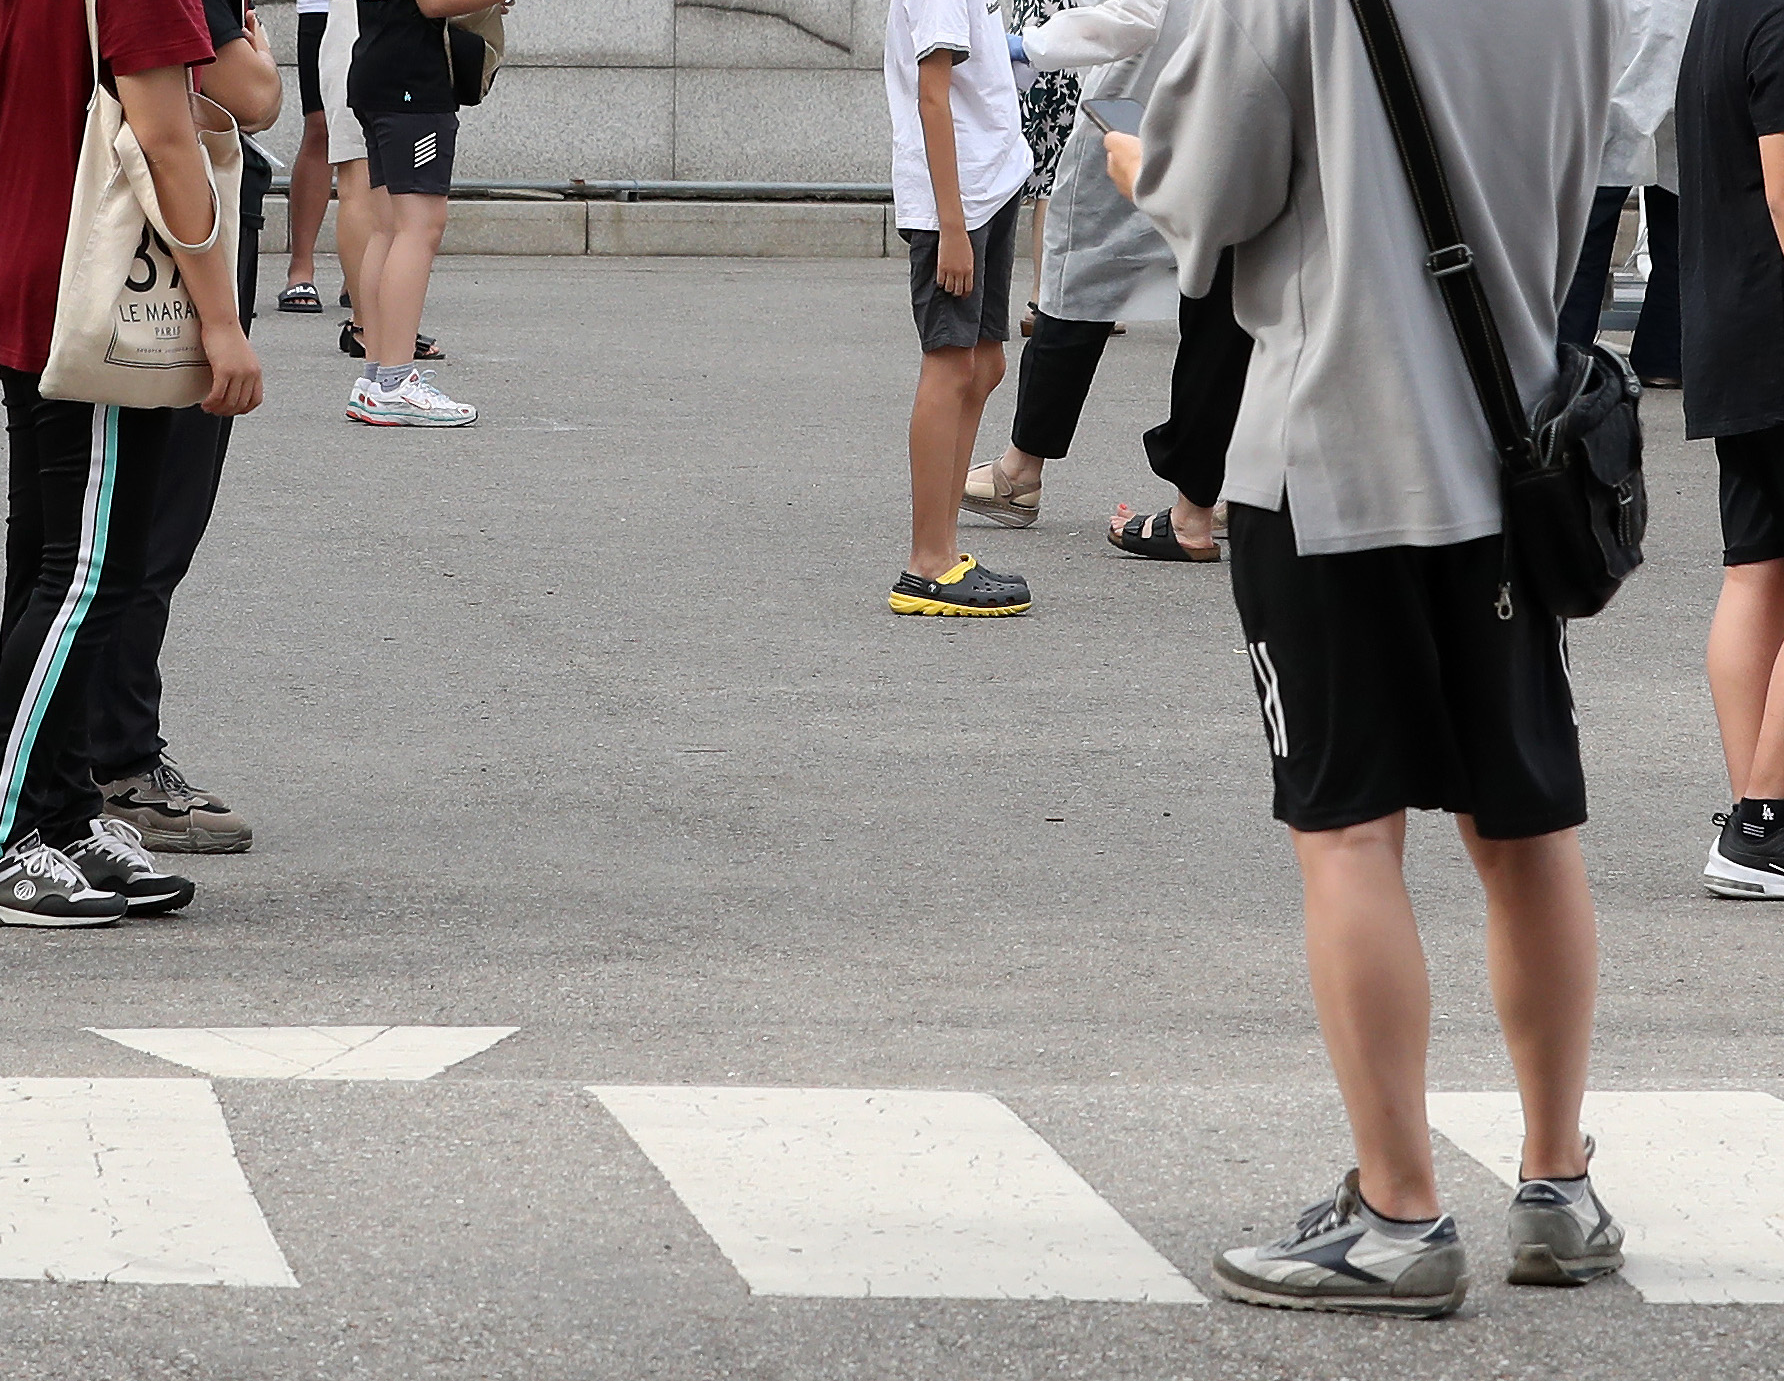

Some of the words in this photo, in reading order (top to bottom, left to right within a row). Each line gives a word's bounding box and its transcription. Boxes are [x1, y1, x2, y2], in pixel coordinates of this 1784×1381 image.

[286, 285, 316, 296] FILA
[119, 303, 141, 323] LE
[154, 325, 181, 338] PARIS
